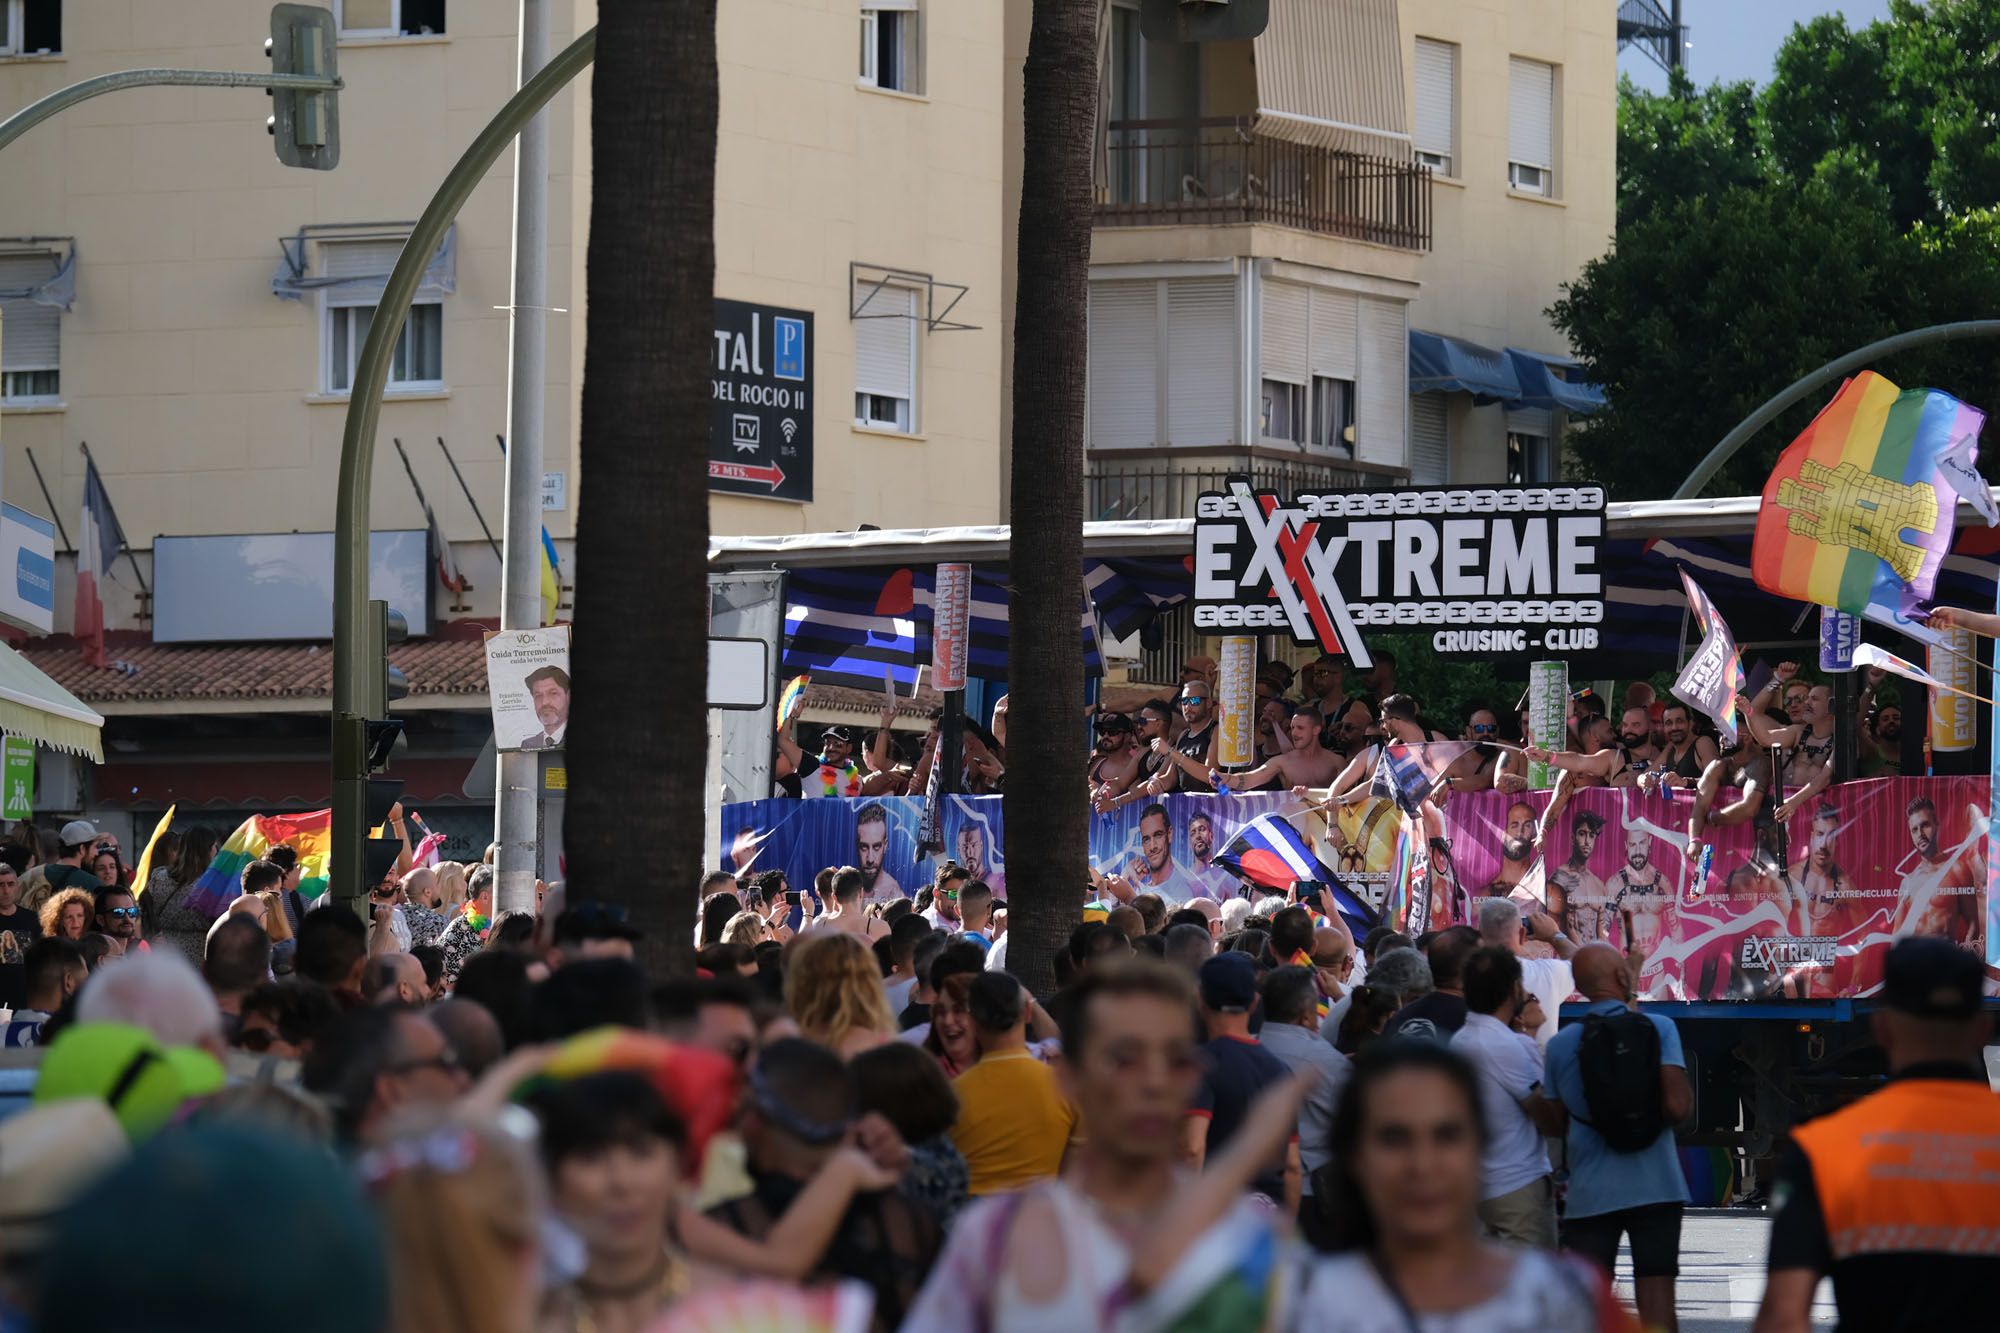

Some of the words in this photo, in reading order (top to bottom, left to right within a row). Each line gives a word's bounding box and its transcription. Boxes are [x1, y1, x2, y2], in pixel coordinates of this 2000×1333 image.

[783, 323, 797, 356] P
[740, 383, 790, 409] ROCIO
[738, 422, 757, 438] TV
[949, 569, 966, 682] EVOLUTION
[516, 634, 536, 645] VOX
[1432, 630, 1526, 653] CRUISING
[1544, 628, 1599, 651] CLUB
[490, 650, 513, 660] Cuida
[513, 646, 566, 658] Torremolinos
